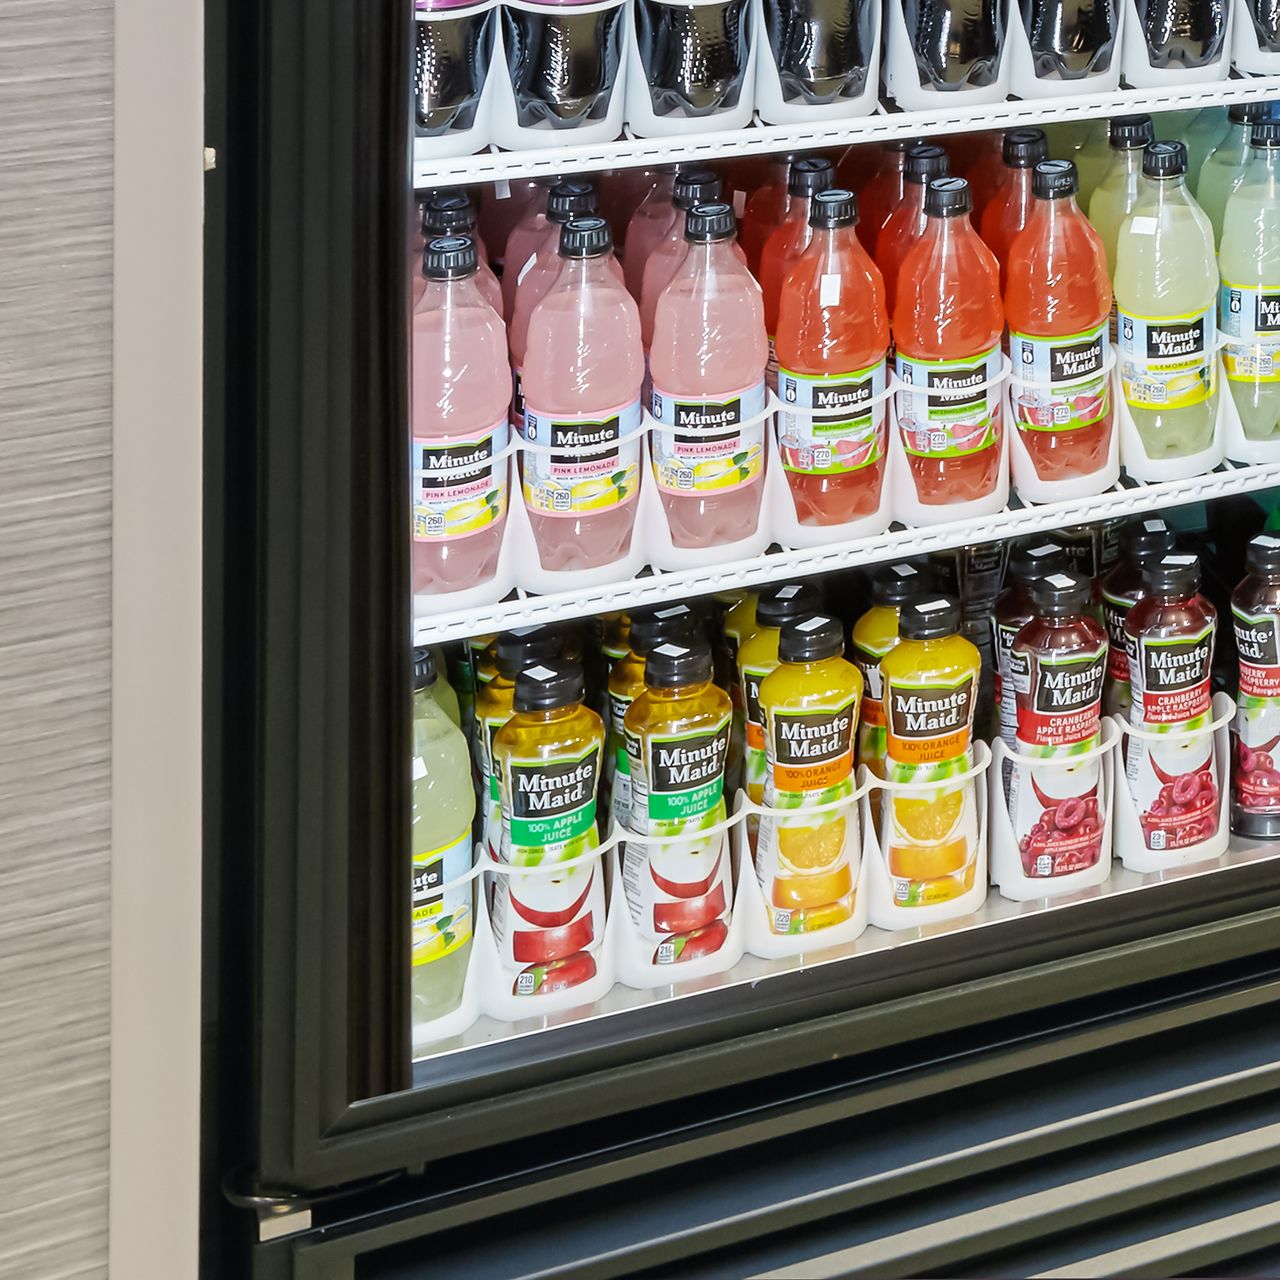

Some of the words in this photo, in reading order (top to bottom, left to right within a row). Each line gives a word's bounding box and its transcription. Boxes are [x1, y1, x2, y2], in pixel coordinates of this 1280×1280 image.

[1151, 328, 1200, 344] Minute
[1055, 345, 1101, 365] Minute
[1158, 340, 1196, 356] Maid
[1061, 358, 1097, 376] Maid
[1154, 359, 1199, 370] LEMONADE
[933, 373, 984, 390] Minute
[817, 387, 870, 405] Minute
[679, 410, 736, 425] Minute
[1055, 407, 1068, 415] 270
[556, 429, 615, 445] Minute
[931, 433, 945, 442] 270
[676, 446, 694, 454] PINK
[695, 441, 737, 452] LEMONADE
[815, 450, 830, 459] 270
[429, 449, 488, 470] Minute
[573, 461, 616, 473] LEMONADE
[425, 491, 446, 499] PINK
[447, 481, 490, 498] LEMONADE
[555, 492, 570, 501] 260
[427, 516, 443, 525] 260
[1149, 646, 1209, 668] Minute
[1043, 665, 1102, 690] Minute
[1158, 664, 1203, 686] Maid
[896, 692, 968, 714] Minute
[1051, 685, 1096, 706] Maid
[1158, 688, 1202, 706] CRANBERRY
[1147, 704, 1172, 714] APPLE
[906, 710, 960, 731] Maid
[1049, 710, 1095, 726] CRANBERRY
[781, 716, 849, 740] Minute
[1036, 725, 1064, 735] APPLE
[790, 736, 841, 758] Maid
[922, 734, 961, 750] ORANGE
[658, 736, 726, 768] Minute
[518, 764, 593, 793] Minute
[668, 756, 719, 785] Maid
[808, 763, 843, 779] ORANGE
[800, 776, 828, 788] JUICE
[528, 782, 586, 810] Maid
[691, 787, 718, 803] APPLE
[680, 799, 709, 816] JUICE
[553, 811, 583, 829] APPLE
[541, 827, 572, 842] JUICE
[519, 974, 534, 985] 210
